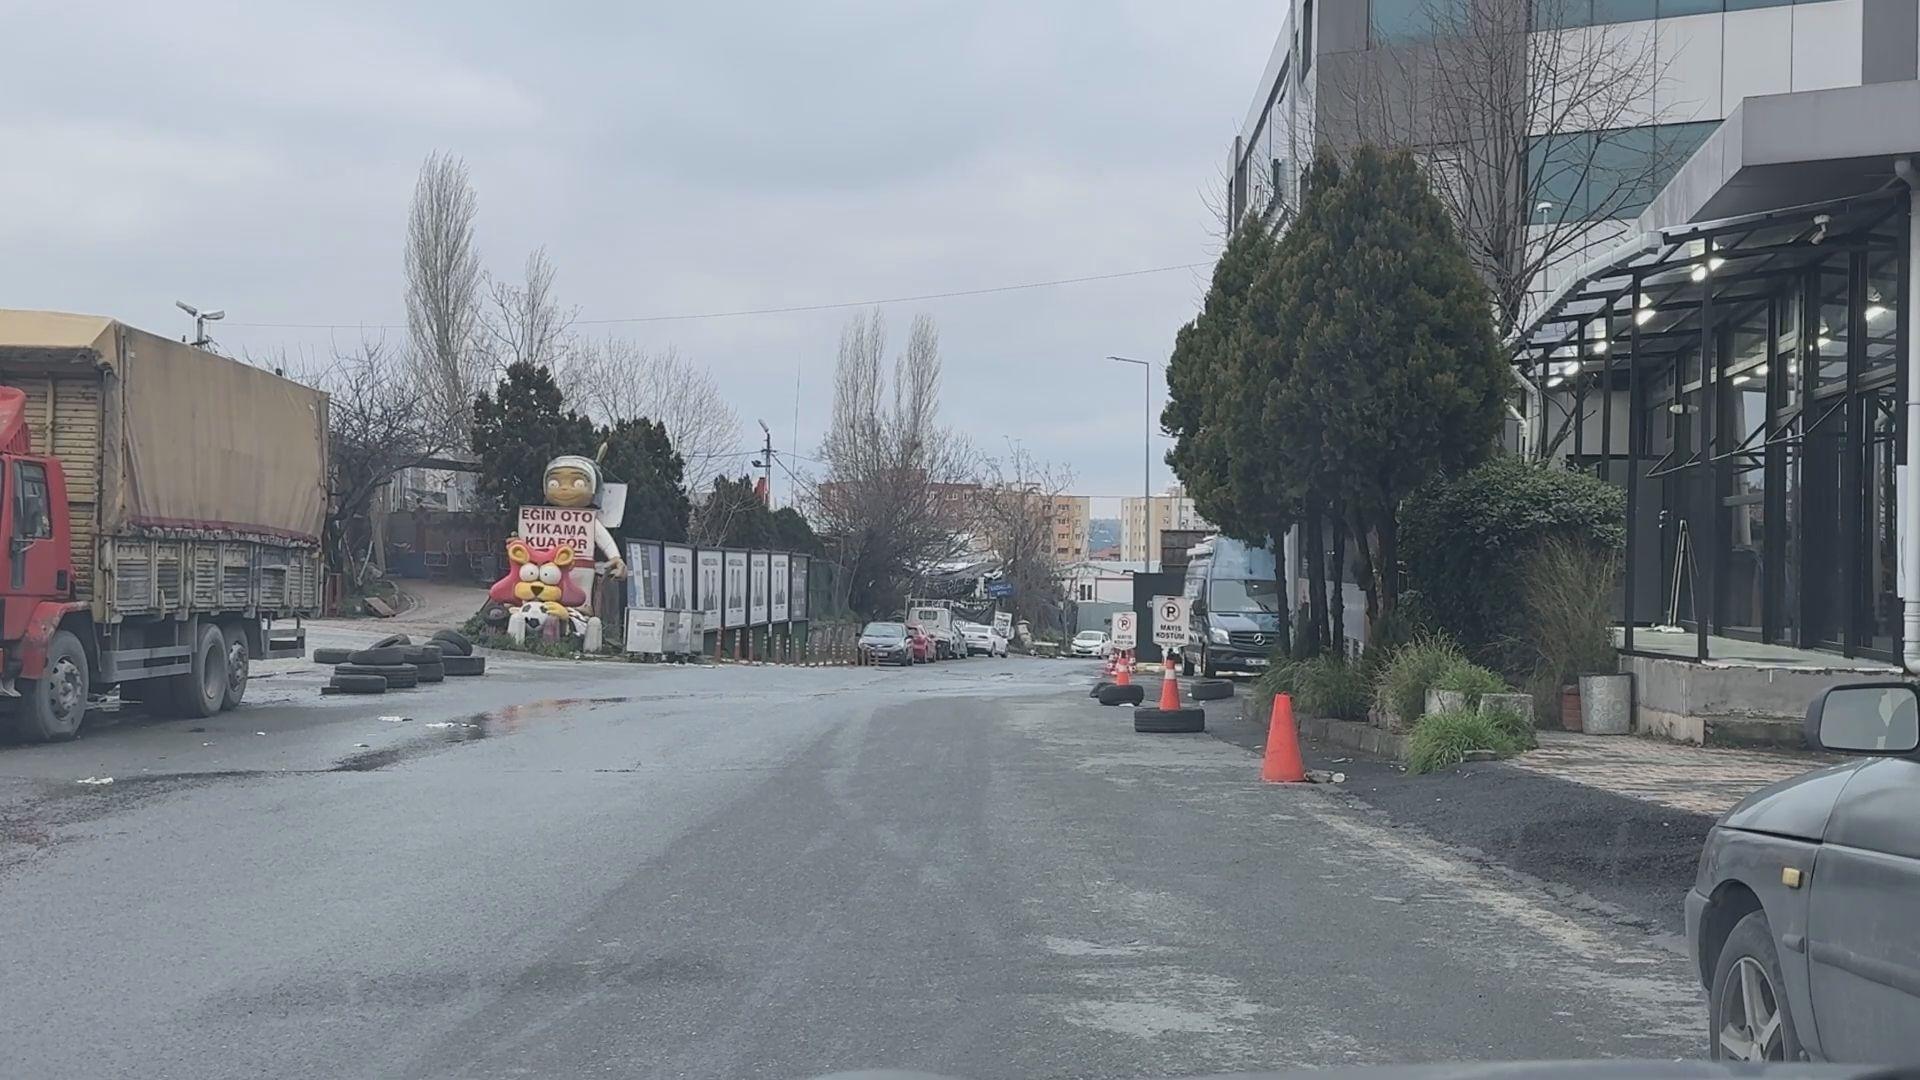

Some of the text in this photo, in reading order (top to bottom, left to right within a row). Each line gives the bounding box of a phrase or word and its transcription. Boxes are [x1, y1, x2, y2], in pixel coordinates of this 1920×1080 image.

[561, 511, 593, 523] OTO
[526, 523, 588, 536] YIKAMA
[1167, 606, 1176, 618] P
